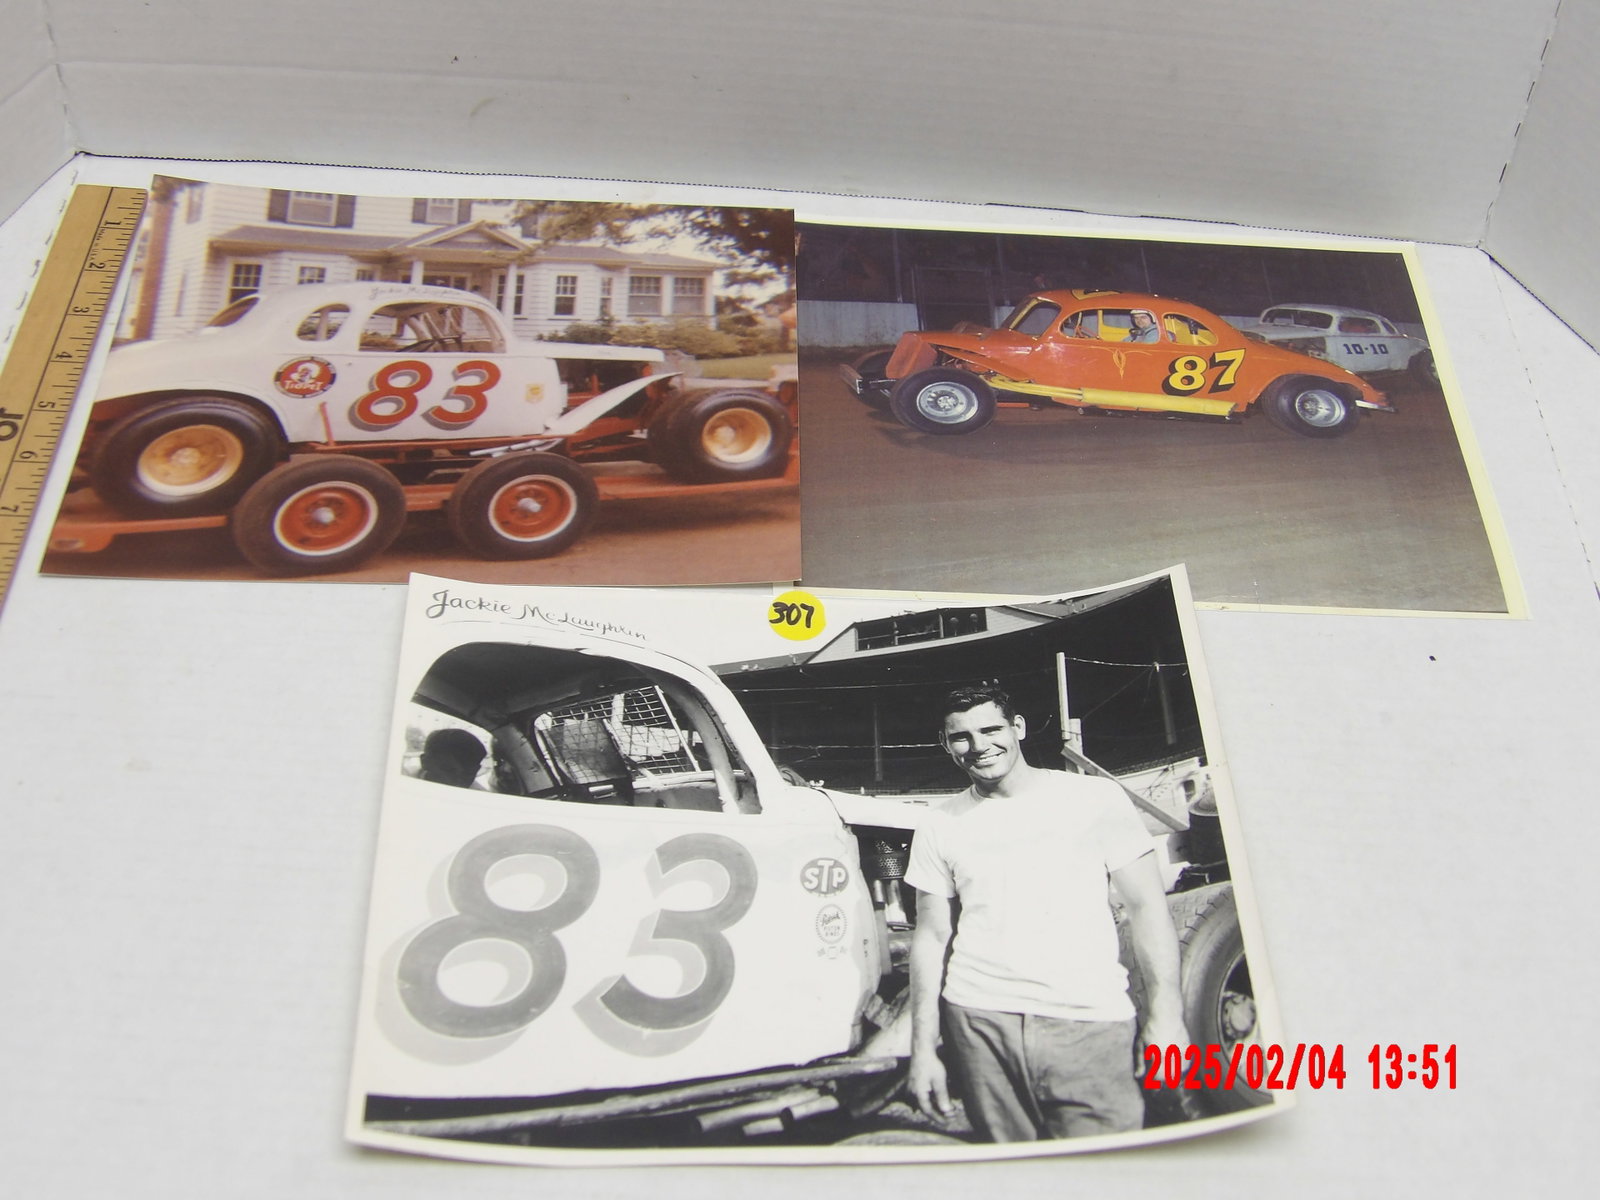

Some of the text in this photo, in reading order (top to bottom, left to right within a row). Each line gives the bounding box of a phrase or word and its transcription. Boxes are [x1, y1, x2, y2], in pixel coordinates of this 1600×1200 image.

[55, 351, 73, 360] 4
[1165, 347, 1246, 395] 87
[353, 360, 502, 427] 83
[20, 450, 38, 460] 6
[1, 505, 20, 513] 7
[426, 589, 512, 619] Jackie
[769, 601, 814, 629] 307
[803, 859, 847, 893] STP
[393, 823, 759, 1040] 83
